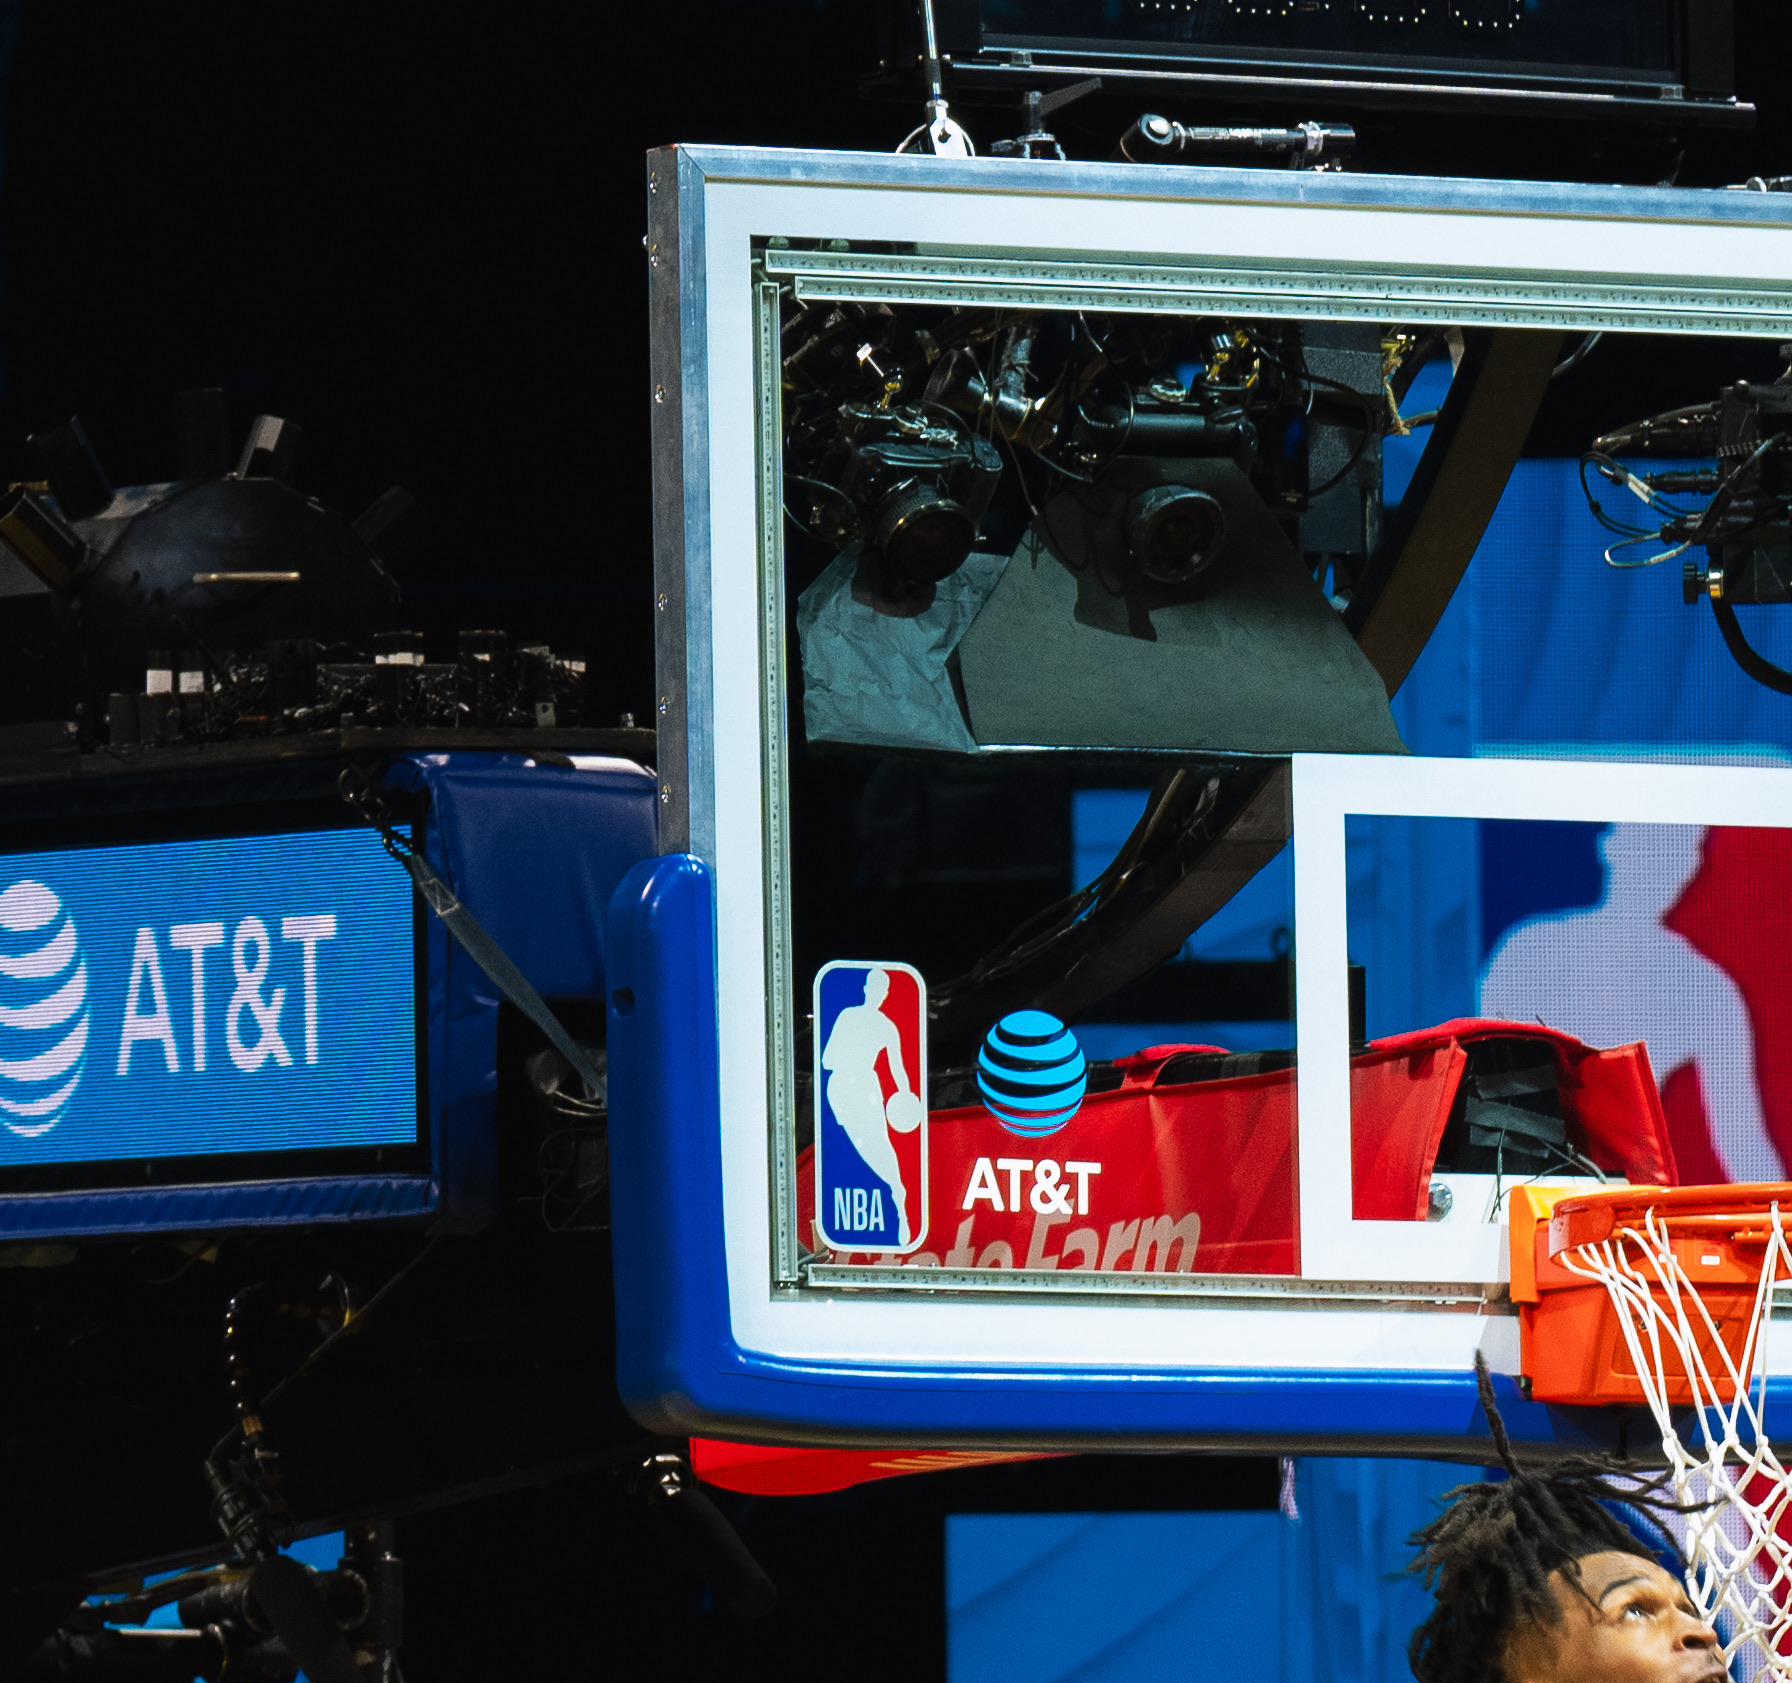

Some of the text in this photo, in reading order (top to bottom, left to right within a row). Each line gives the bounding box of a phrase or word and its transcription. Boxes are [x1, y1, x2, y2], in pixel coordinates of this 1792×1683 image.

[116, 913, 338, 1077] AT&T
[833, 1186, 886, 1233] NBA
[961, 1157, 1102, 1215] AT&T
